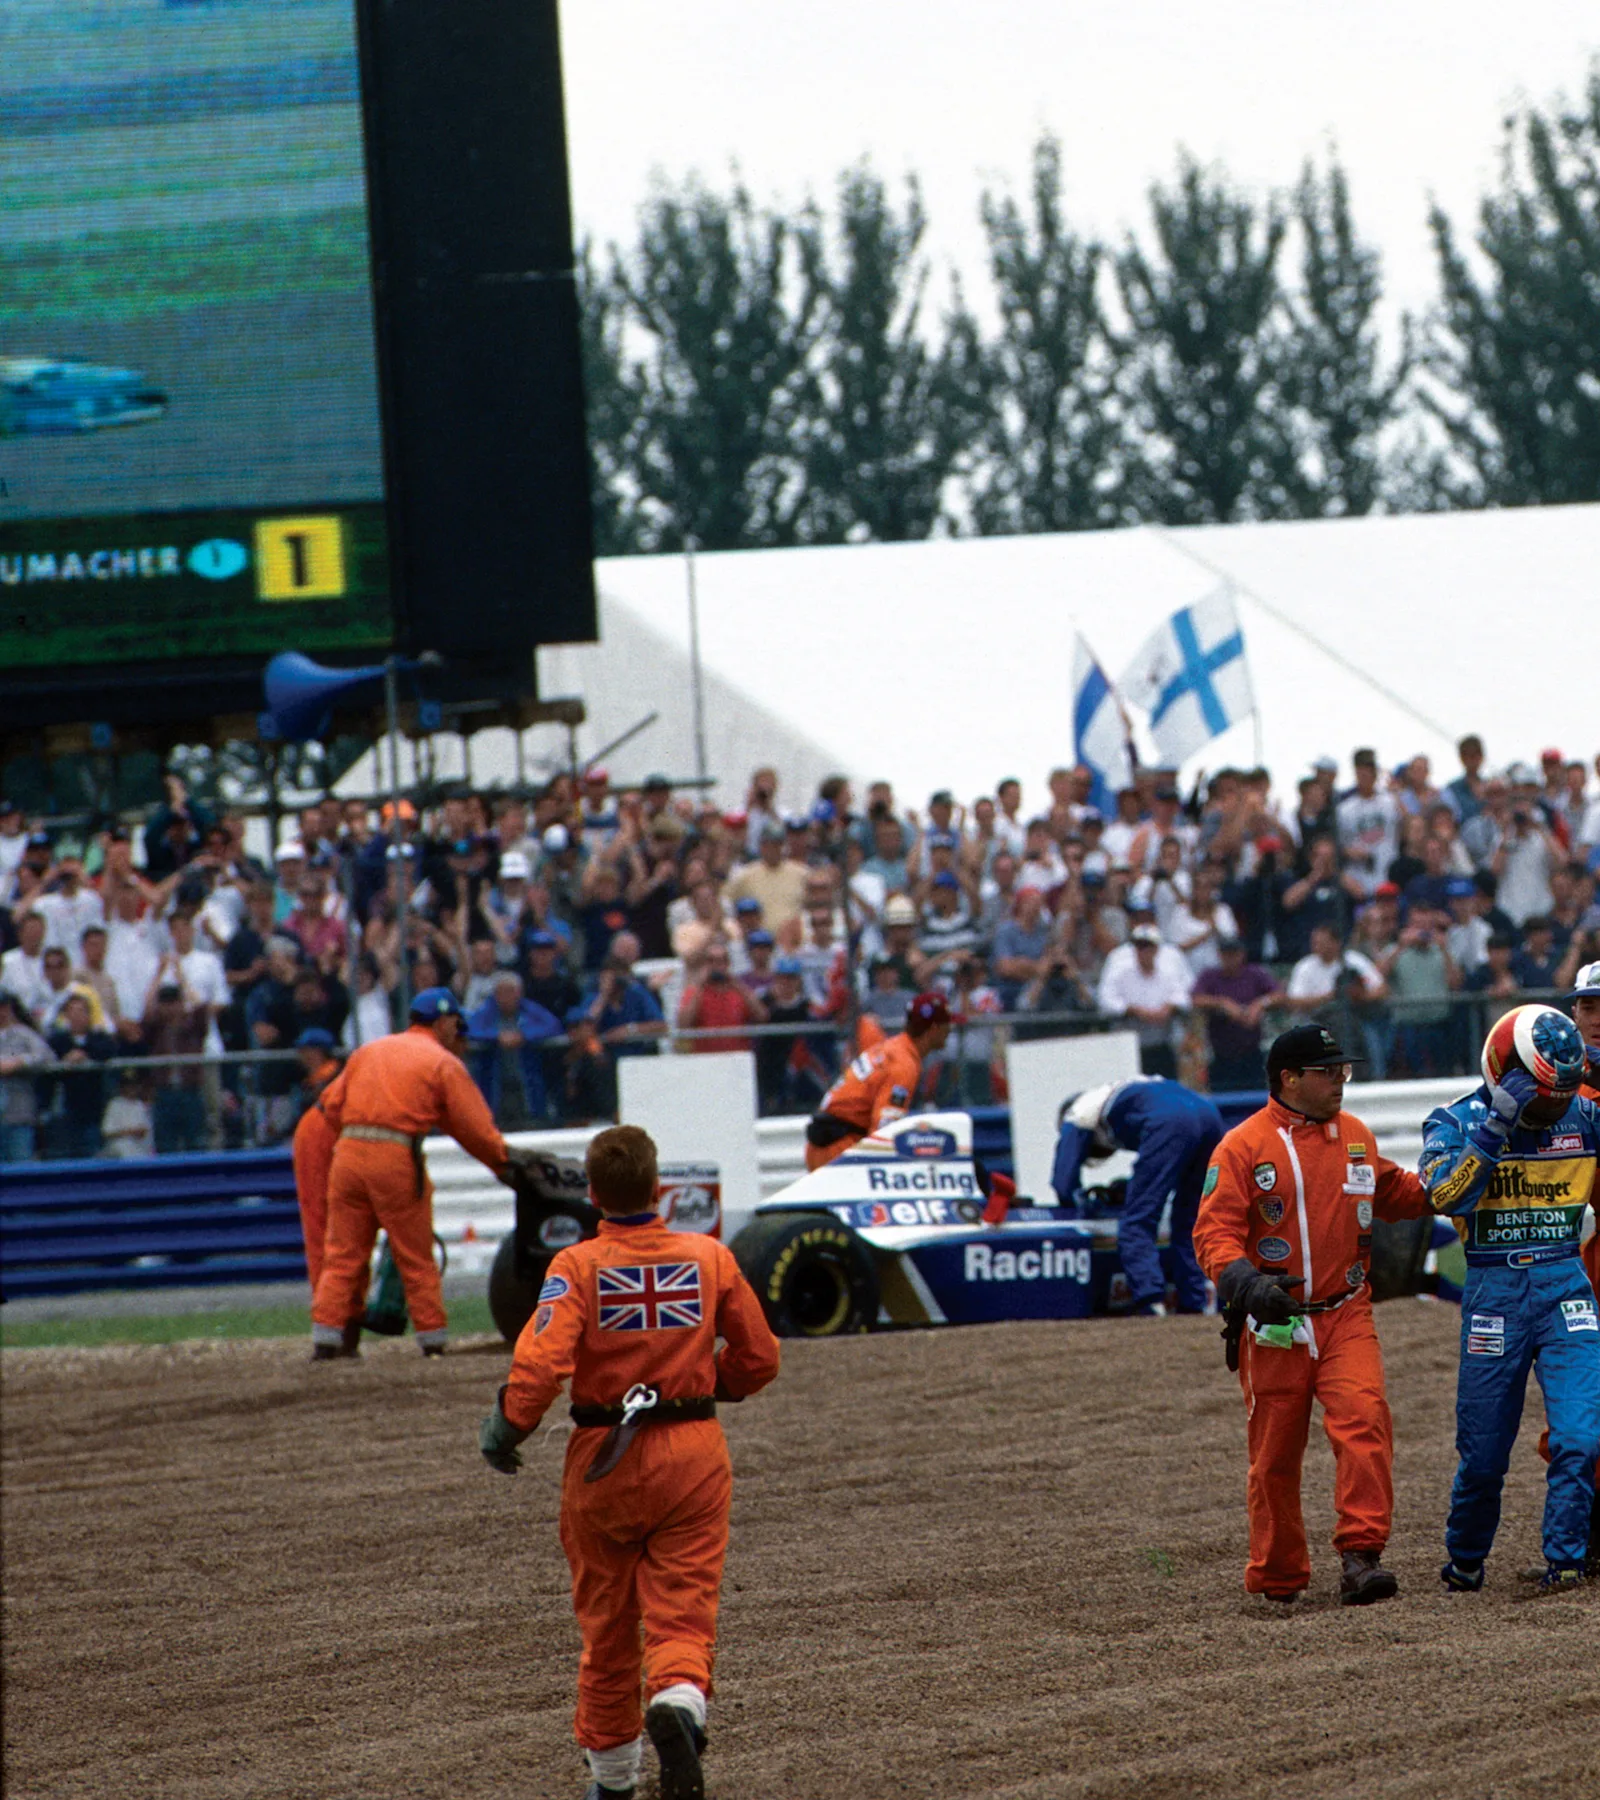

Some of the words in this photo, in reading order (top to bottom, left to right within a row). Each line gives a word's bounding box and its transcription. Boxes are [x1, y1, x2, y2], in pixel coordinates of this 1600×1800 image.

[283, 535, 311, 588] 1
[868, 1165, 975, 1196] Racing
[890, 1201, 948, 1225] elf
[965, 1241, 1091, 1283] Racing
